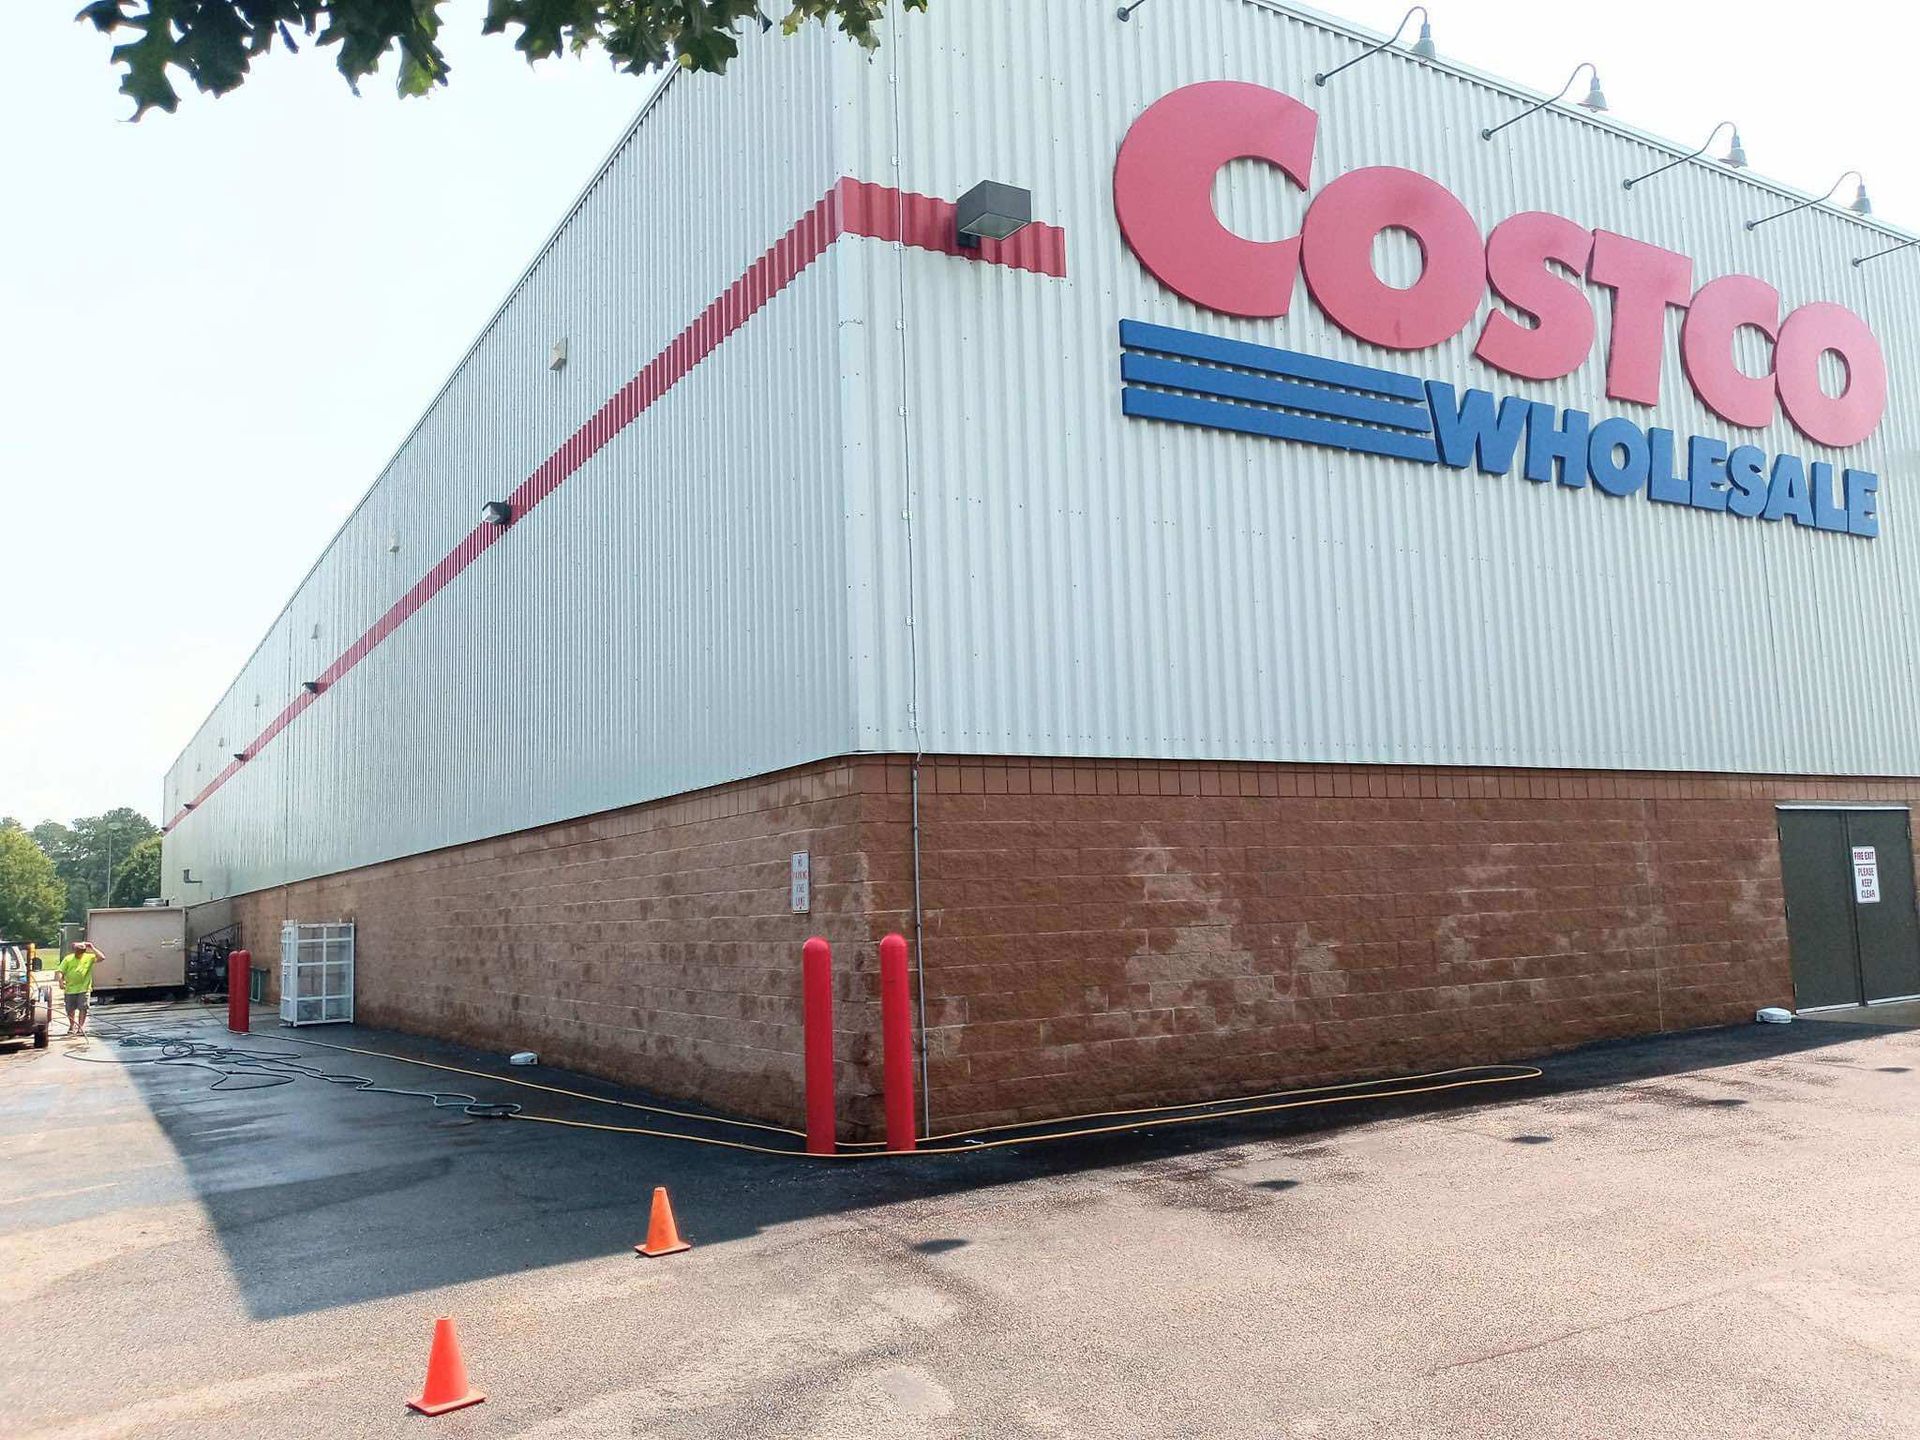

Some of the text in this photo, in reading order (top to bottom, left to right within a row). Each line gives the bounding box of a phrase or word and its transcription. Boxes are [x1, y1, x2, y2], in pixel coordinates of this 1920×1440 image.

[1114, 80, 1887, 448] COSTCO
[1425, 380, 1879, 538] WHOLESALE
[1854, 851, 1874, 860] FIRE EXIT
[1857, 867, 1874, 876] PLEASE
[1861, 878, 1872, 887] KEEP
[1861, 889, 1876, 898] CLEAR
